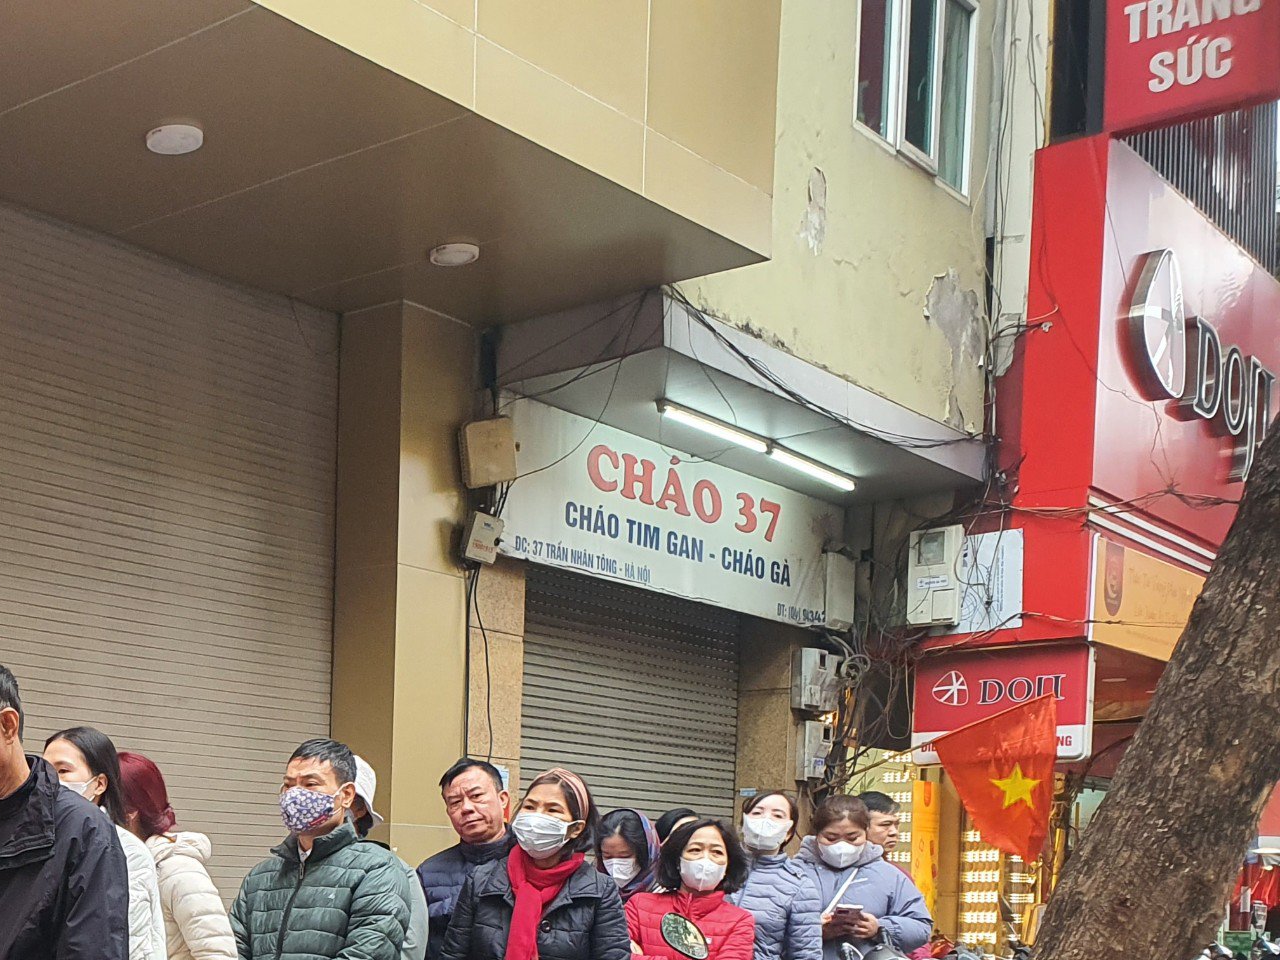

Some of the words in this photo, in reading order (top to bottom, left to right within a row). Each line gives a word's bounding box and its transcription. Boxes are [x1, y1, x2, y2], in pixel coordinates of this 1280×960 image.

[1148, 34, 1233, 93] SỨC
[586, 444, 723, 524] CHÁO
[734, 492, 781, 543] 37
[532, 540, 544, 556] 37
[571, 549, 594, 570] NHÂN
[596, 554, 617, 575] TÔNG
[624, 562, 636, 580] HÀ
[565, 500, 620, 539] CHÁO
[626, 518, 660, 551] TIM
[666, 531, 704, 563] GAN
[721, 546, 765, 580] CHÁO
[770, 559, 791, 587] GÀ
